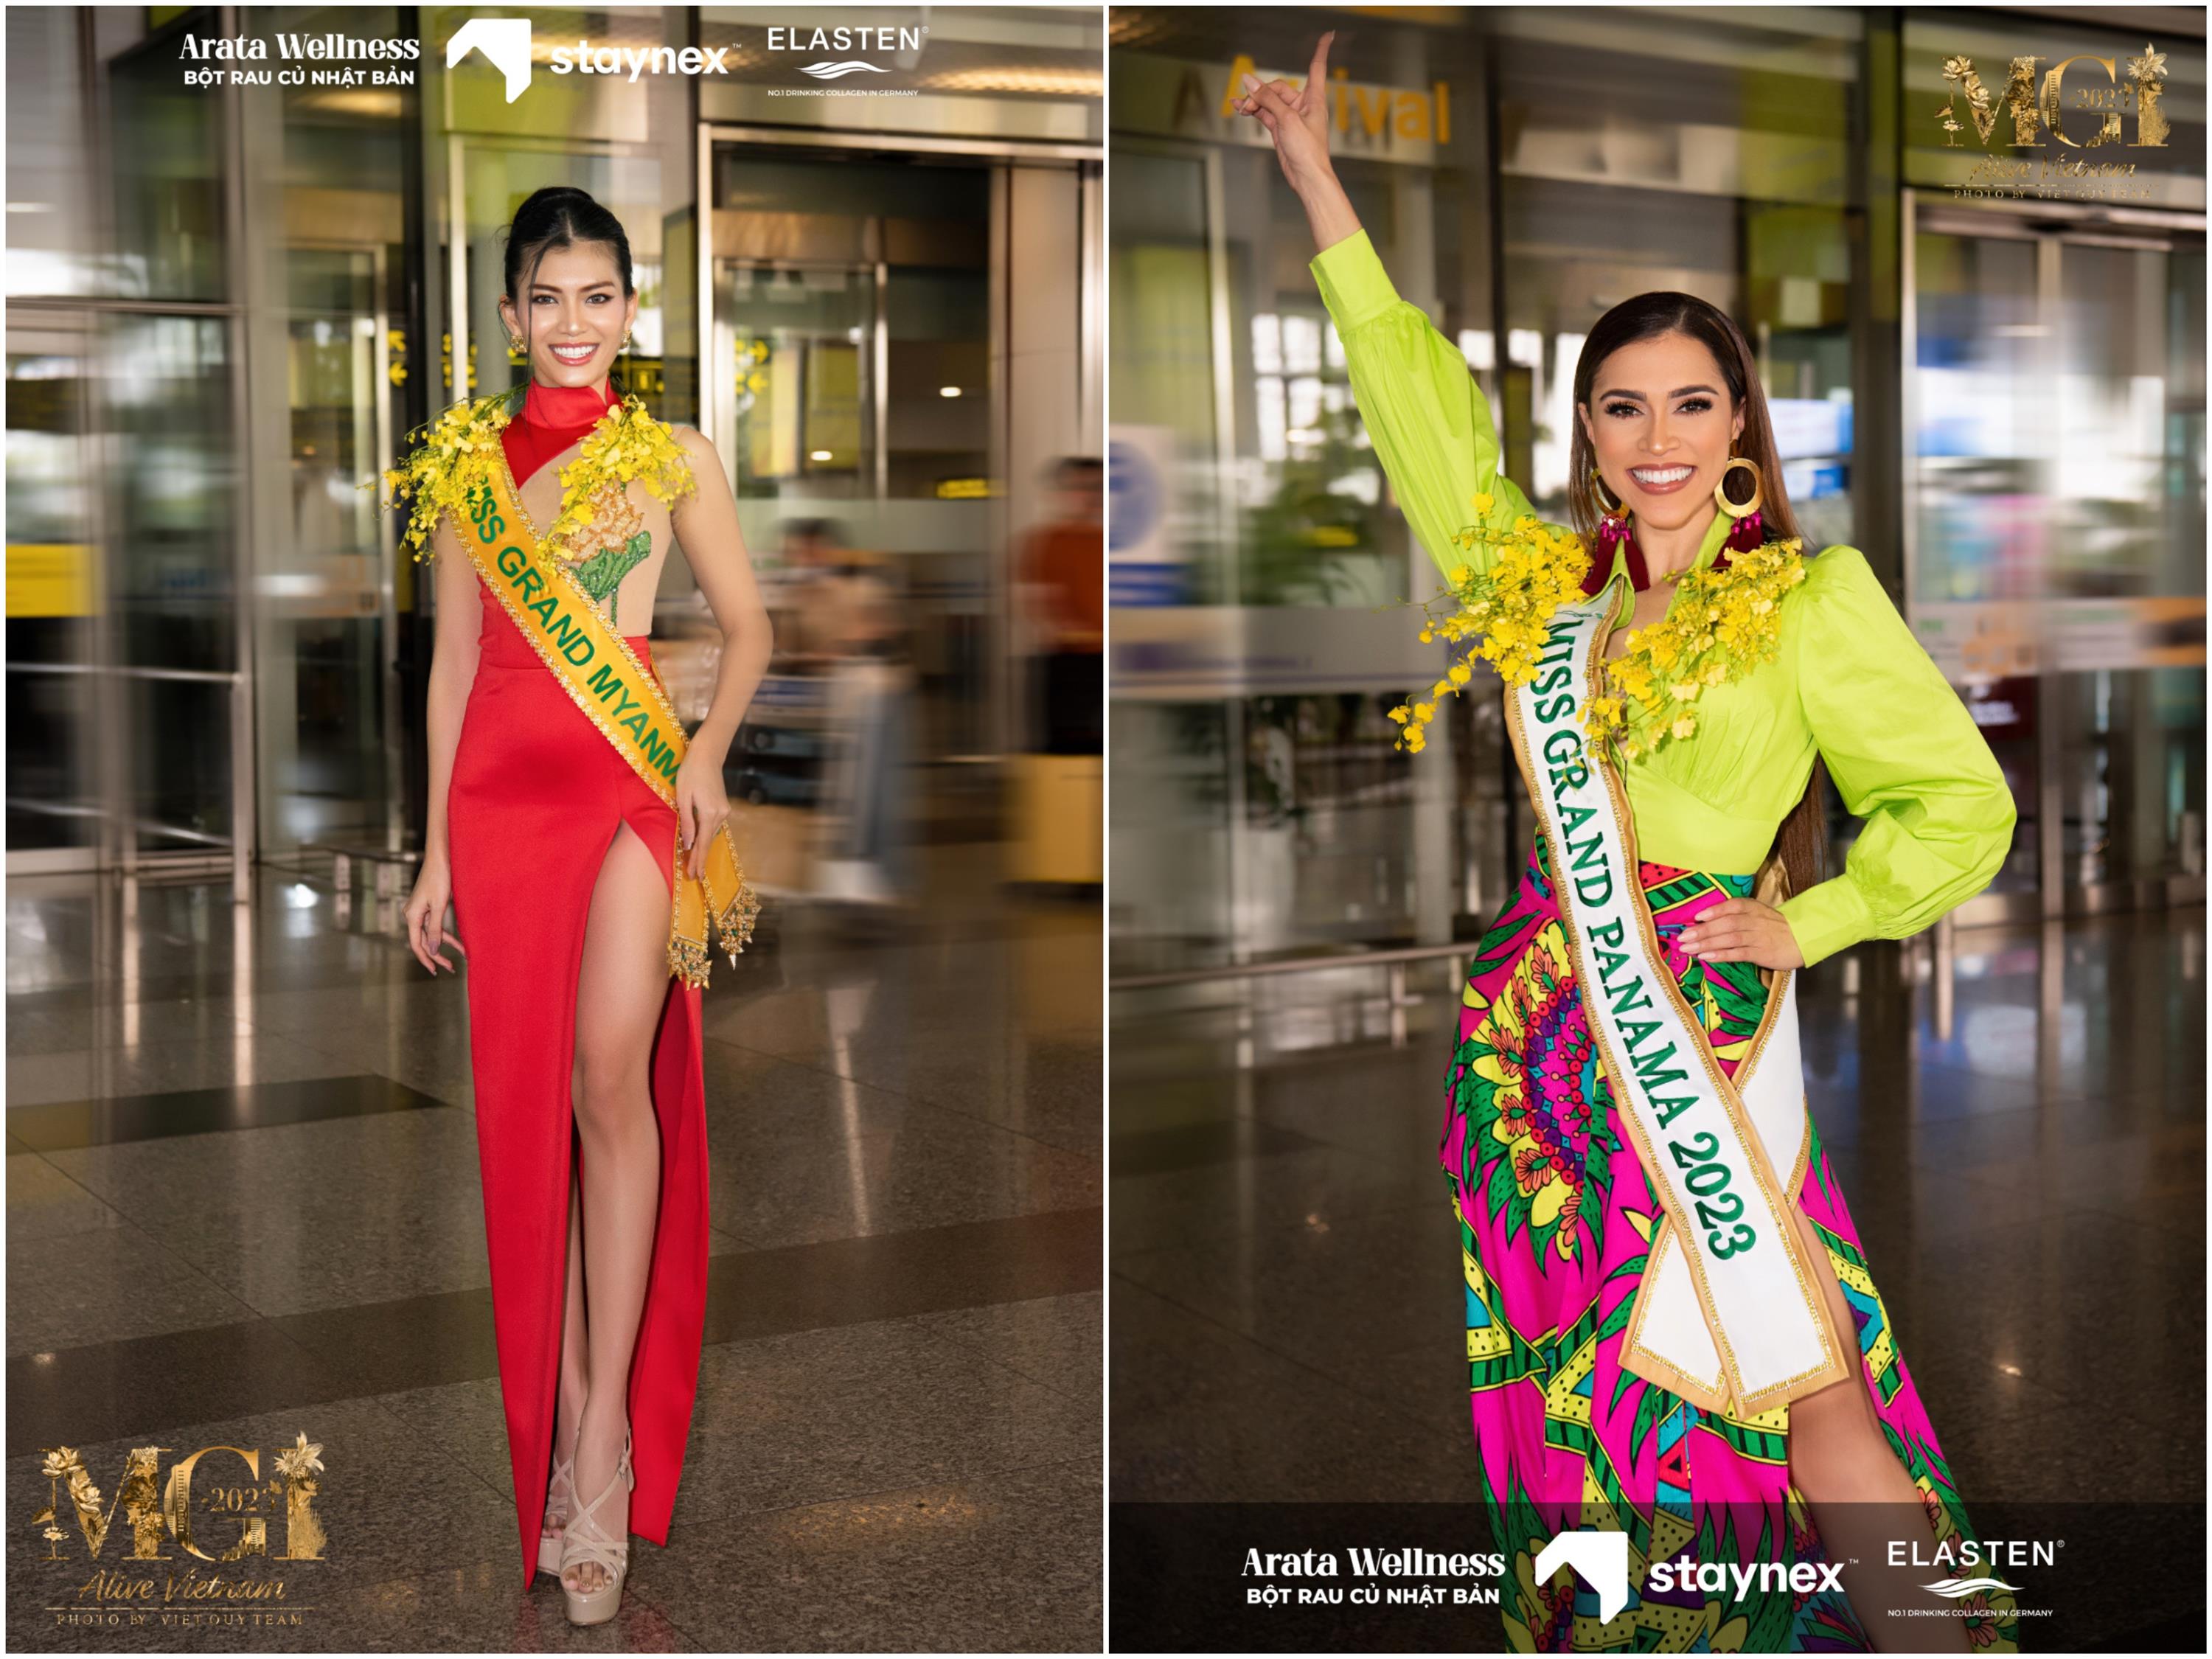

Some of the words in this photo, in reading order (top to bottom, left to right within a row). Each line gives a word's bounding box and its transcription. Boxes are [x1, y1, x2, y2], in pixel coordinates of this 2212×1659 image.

[1220, 55, 1450, 145] Aival
[467, 476, 505, 544] ISS
[497, 546, 595, 667] GRAND
[1530, 619, 1585, 724] MISS
[1544, 728, 1613, 908] GRAND
[1587, 917, 1700, 1130] PANAMA
[1669, 1132, 1757, 1261] 2023
